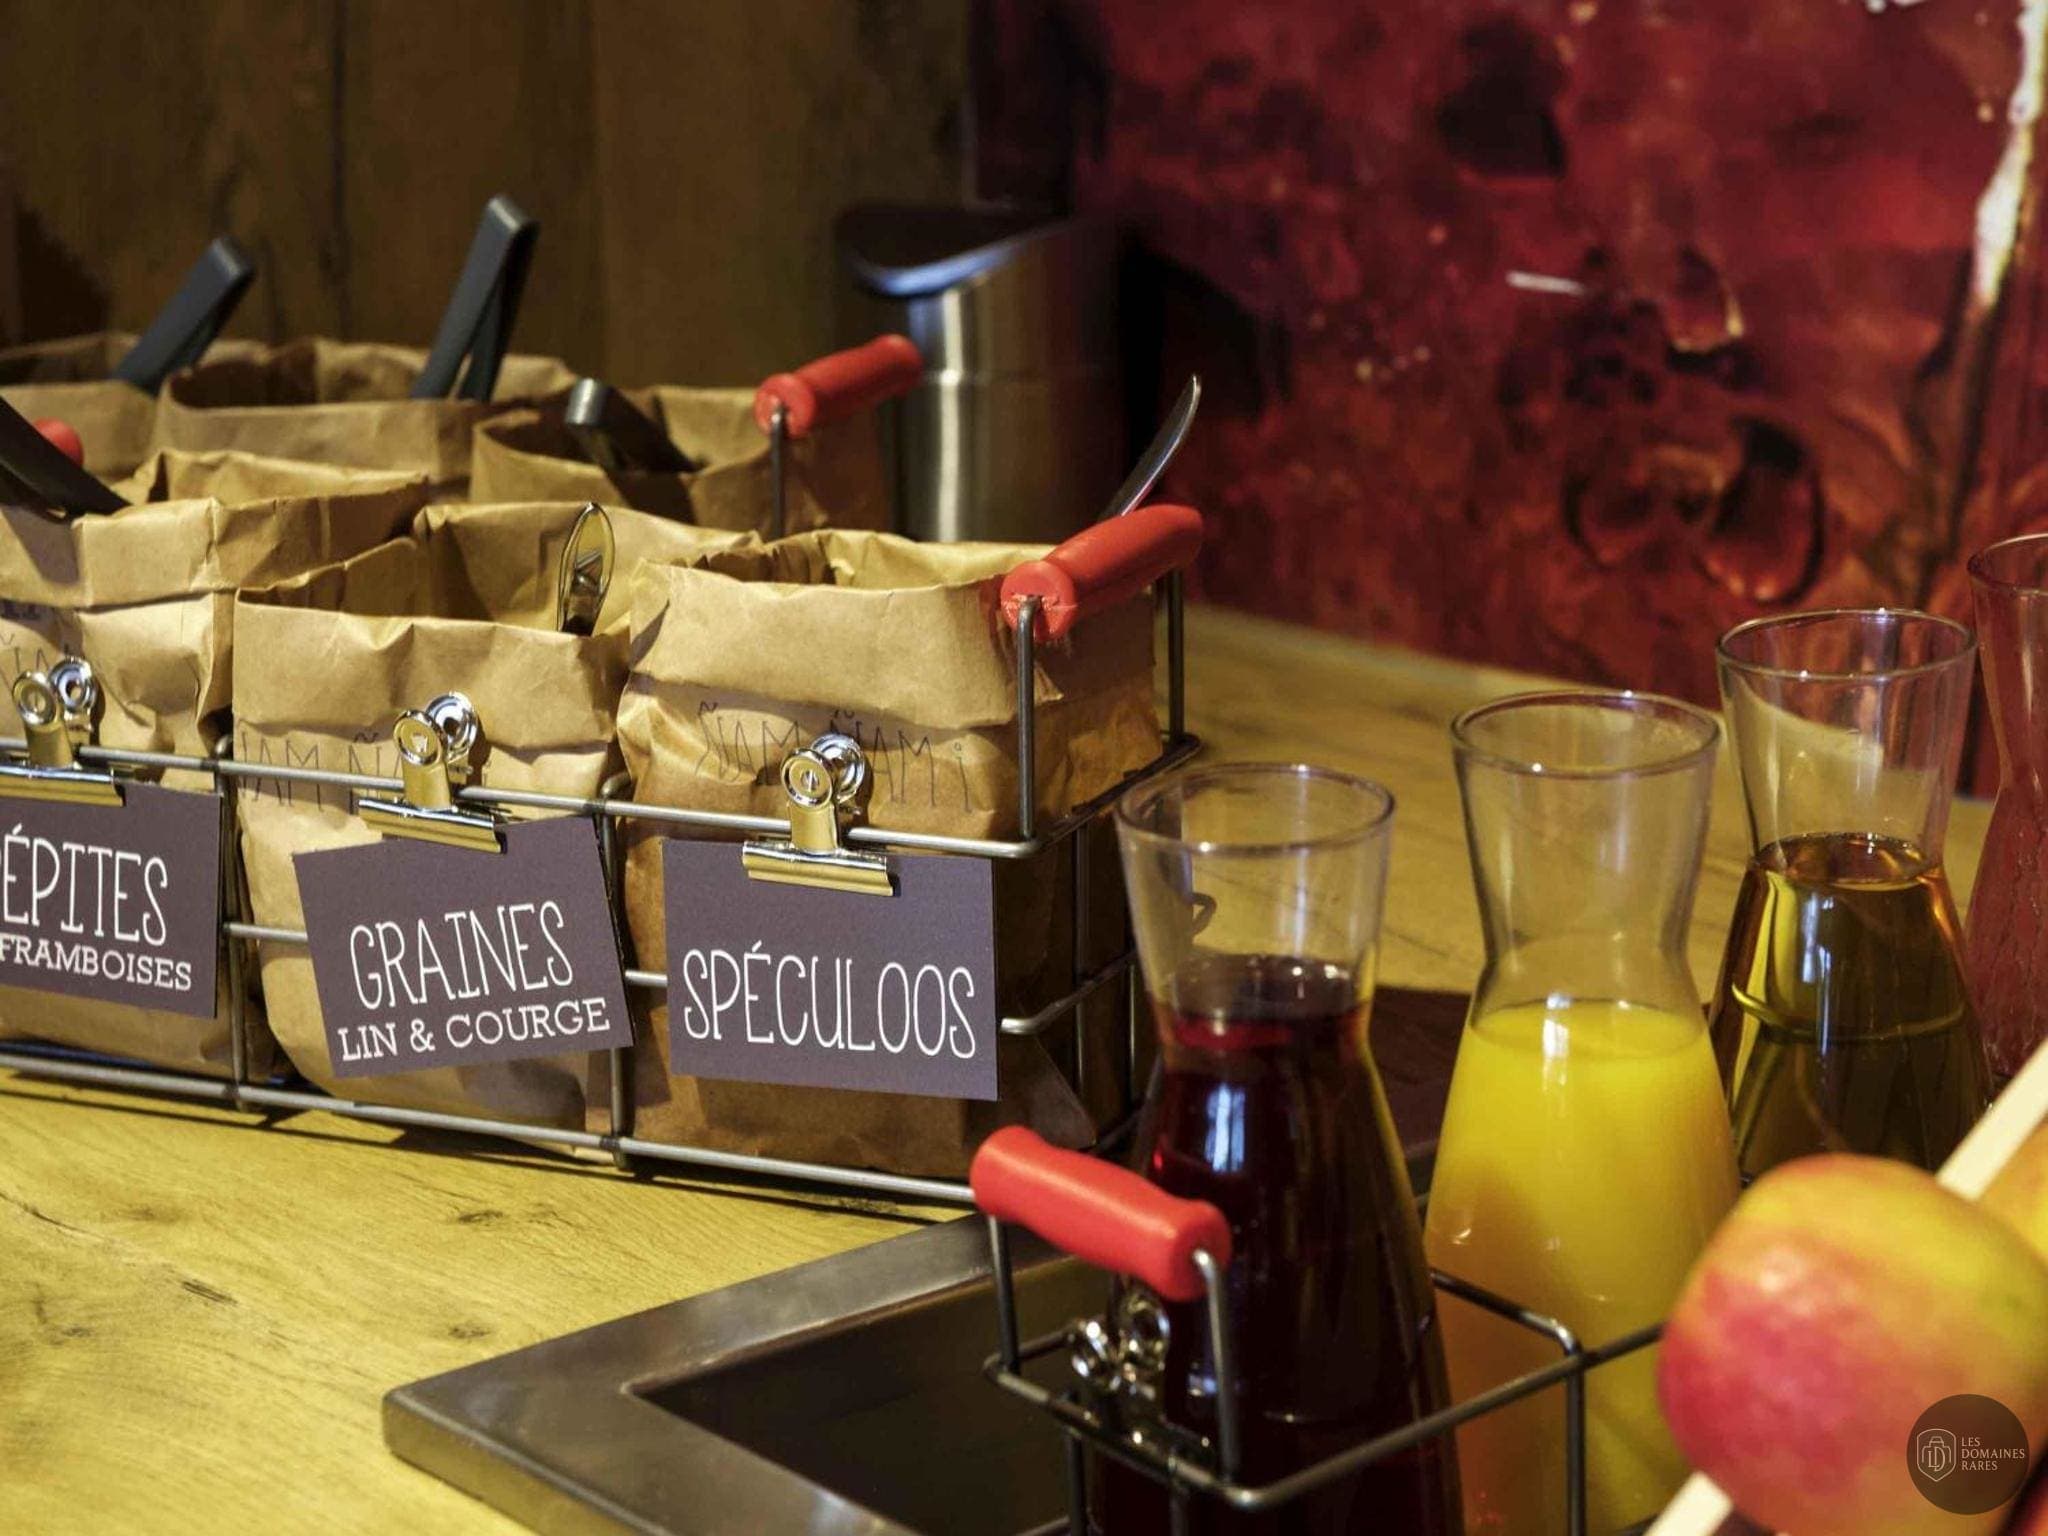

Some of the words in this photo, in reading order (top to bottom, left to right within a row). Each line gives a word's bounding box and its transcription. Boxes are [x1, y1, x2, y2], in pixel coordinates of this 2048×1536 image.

[0, 822, 168, 947] ÉPITES
[0, 932, 192, 991] FRAMBOISES
[349, 899, 574, 1010] GRAINES
[683, 939, 977, 1060] SPÉCULOOS
[337, 1022, 398, 1062] LIN
[409, 1017, 437, 1054] &
[445, 996, 611, 1049] COURGE
